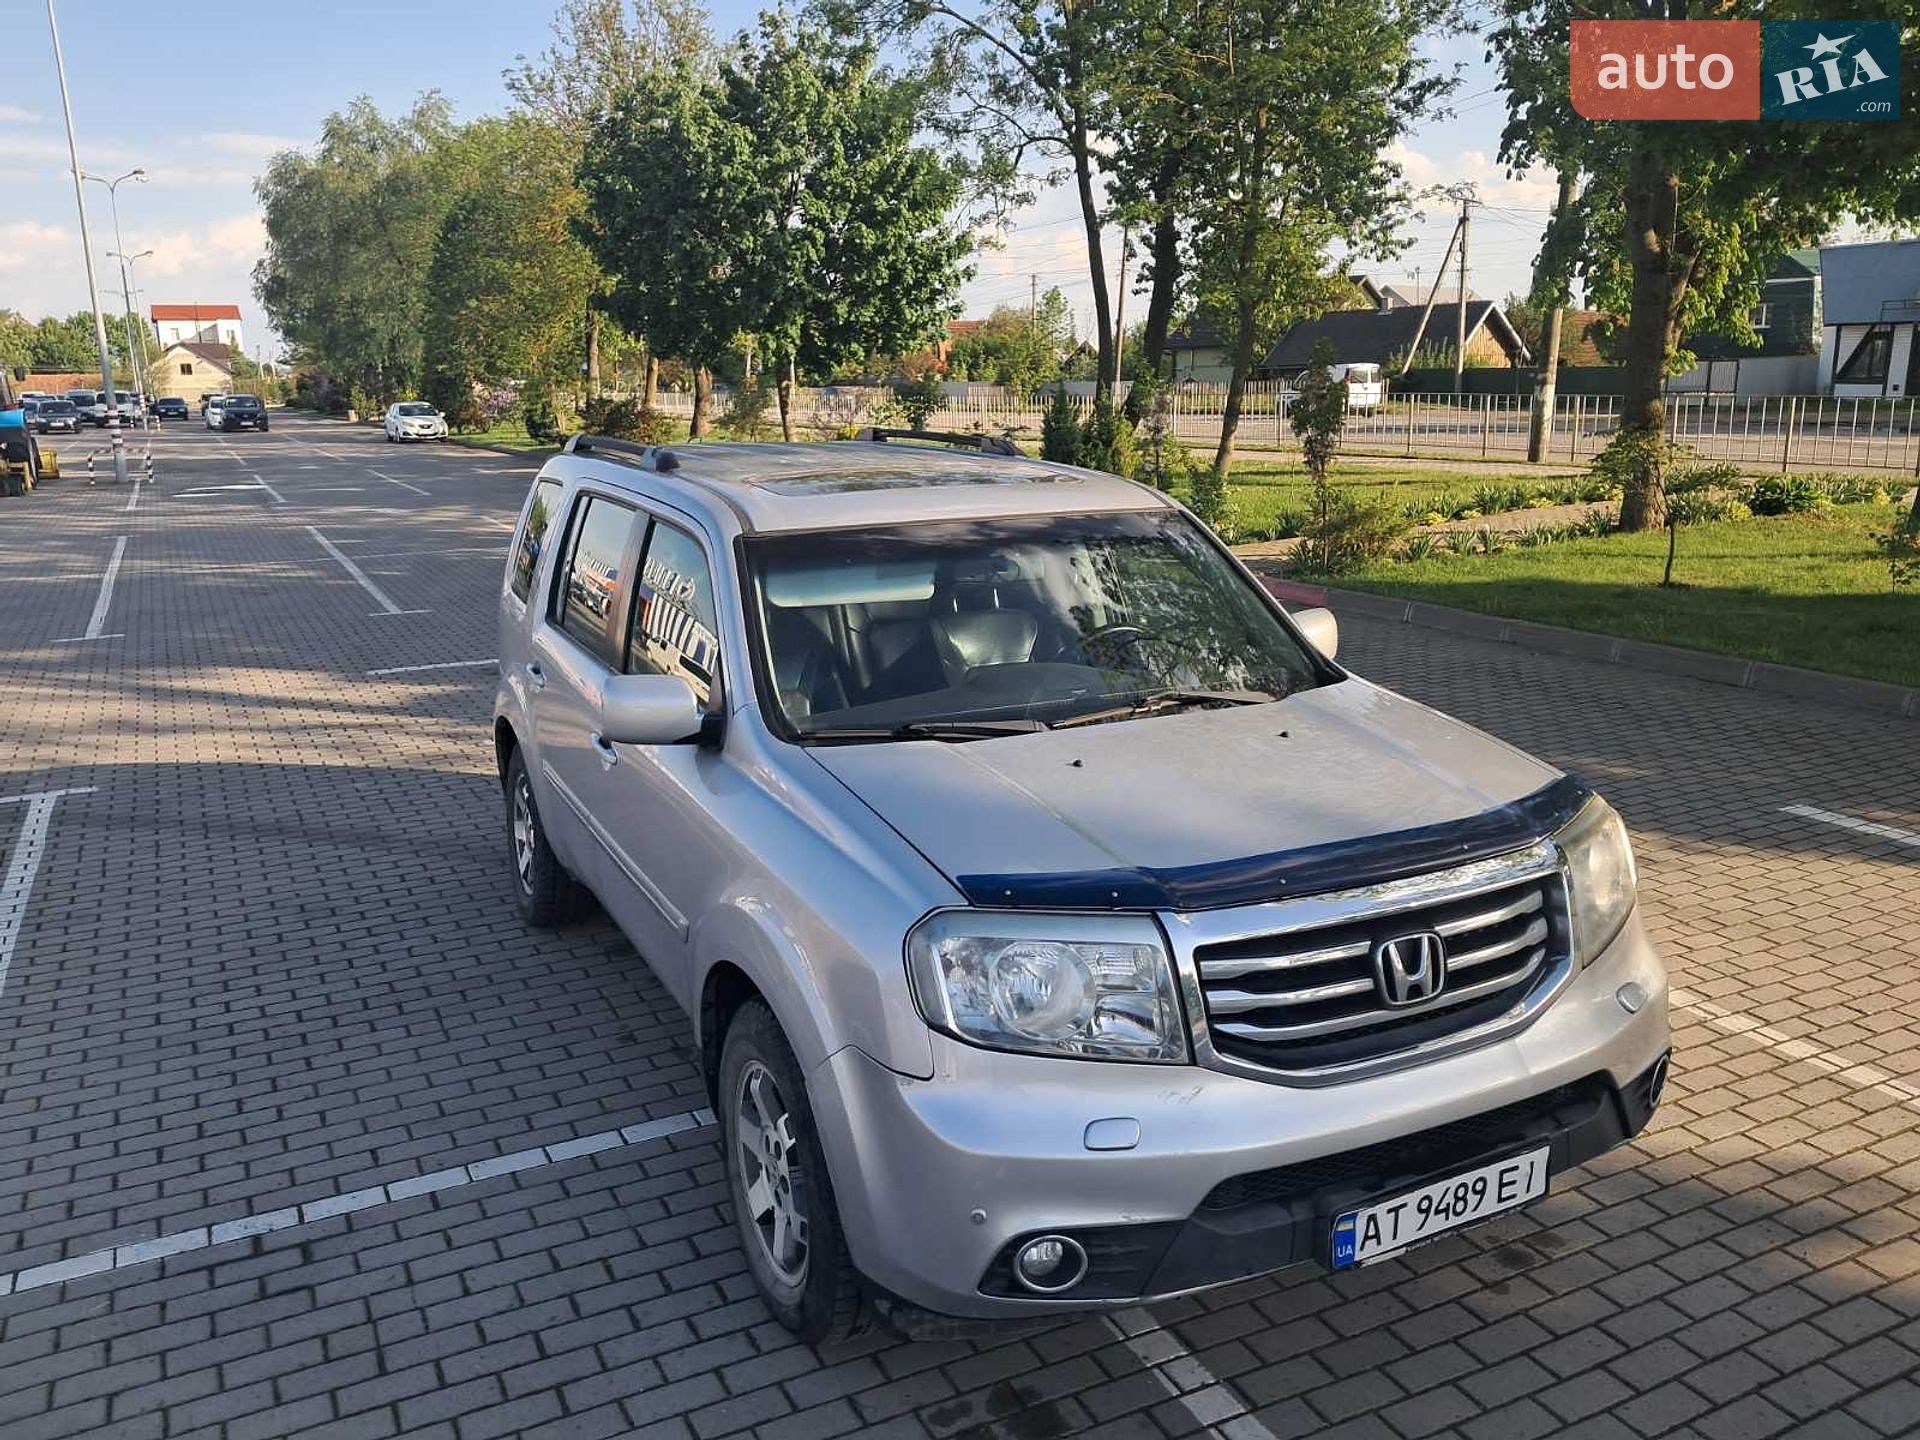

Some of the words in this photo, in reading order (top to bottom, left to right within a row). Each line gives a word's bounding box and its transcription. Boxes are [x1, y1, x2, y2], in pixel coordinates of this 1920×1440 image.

[1359, 1201, 1409, 1252] AT
[1415, 1175, 1488, 1232] 9489
[1497, 1160, 1535, 1204] EI
[1336, 1244, 1354, 1258] UA
